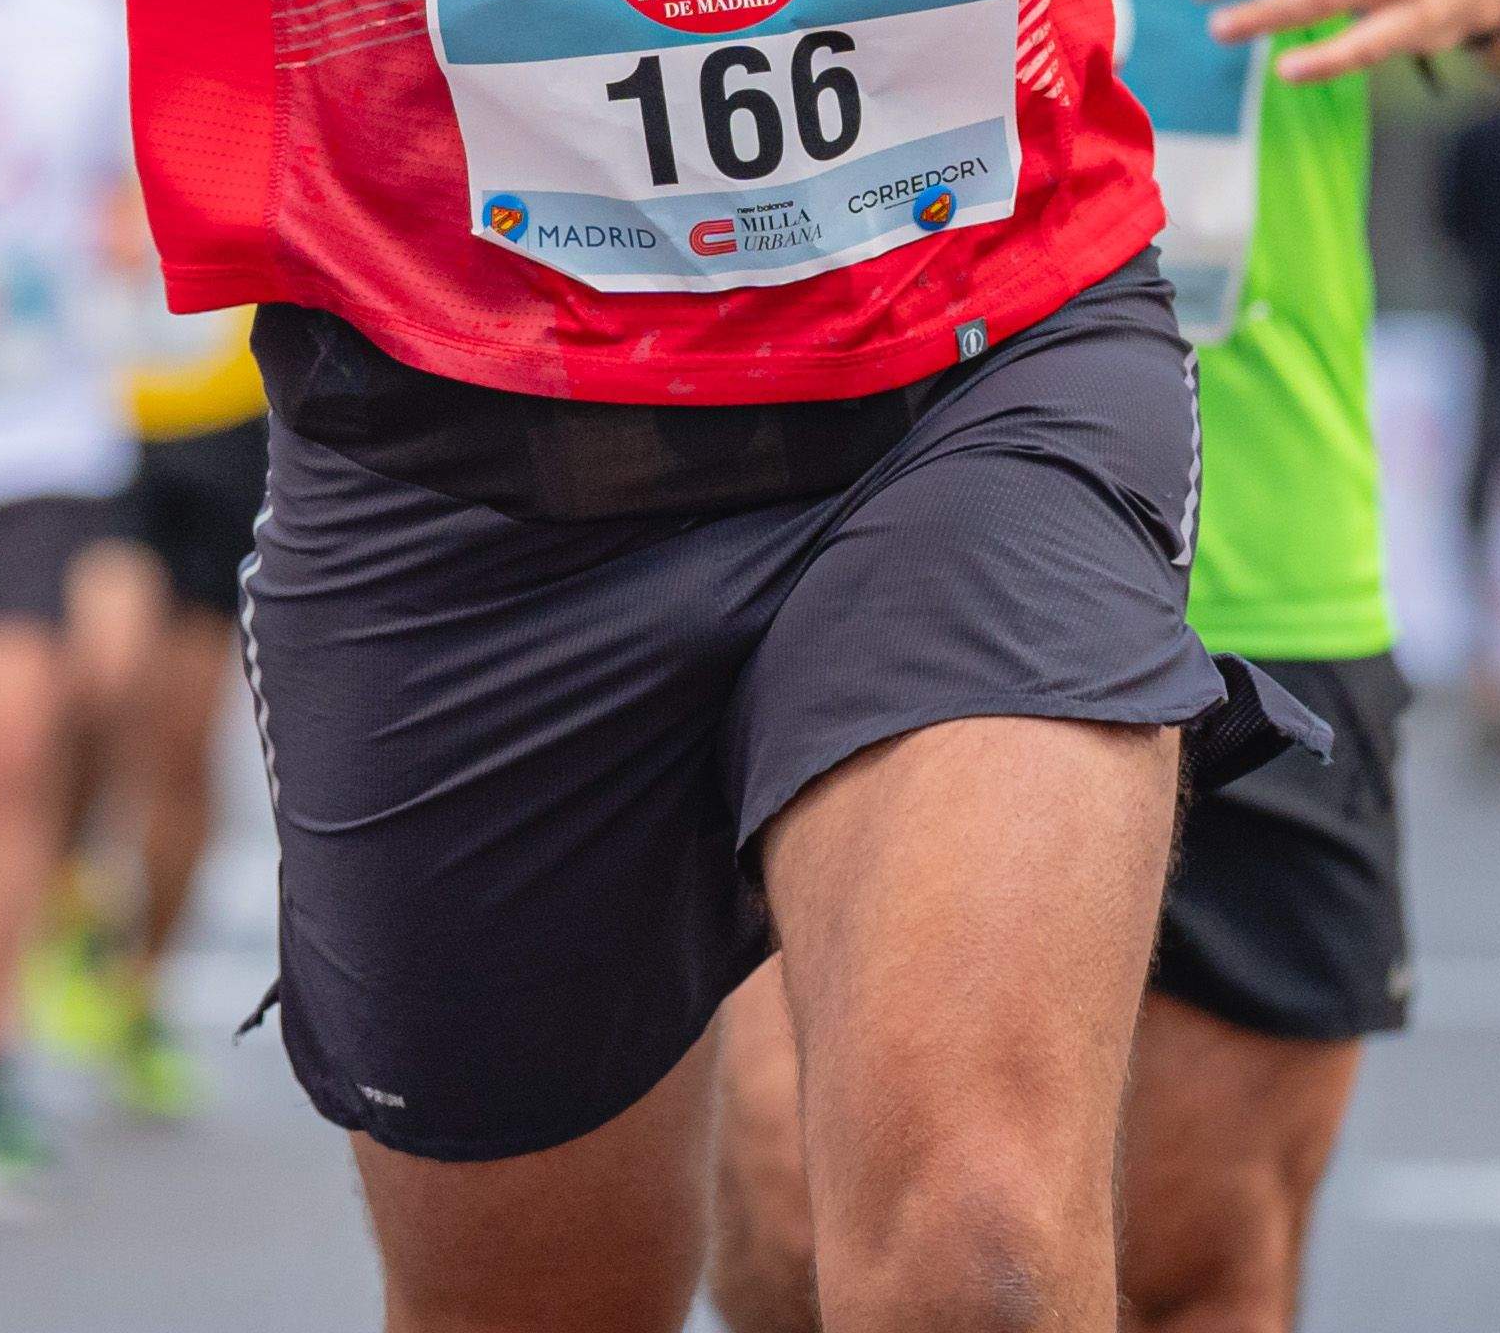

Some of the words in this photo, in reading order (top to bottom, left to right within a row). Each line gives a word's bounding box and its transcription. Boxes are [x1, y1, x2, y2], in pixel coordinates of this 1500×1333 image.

[664, 0, 693, 19] DE
[605, 29, 862, 187] 166
[736, 206, 755, 214] new
[757, 200, 794, 212] balance
[740, 208, 811, 233] MILLA
[538, 225, 657, 249] MADRID
[744, 223, 822, 251] URBANA
